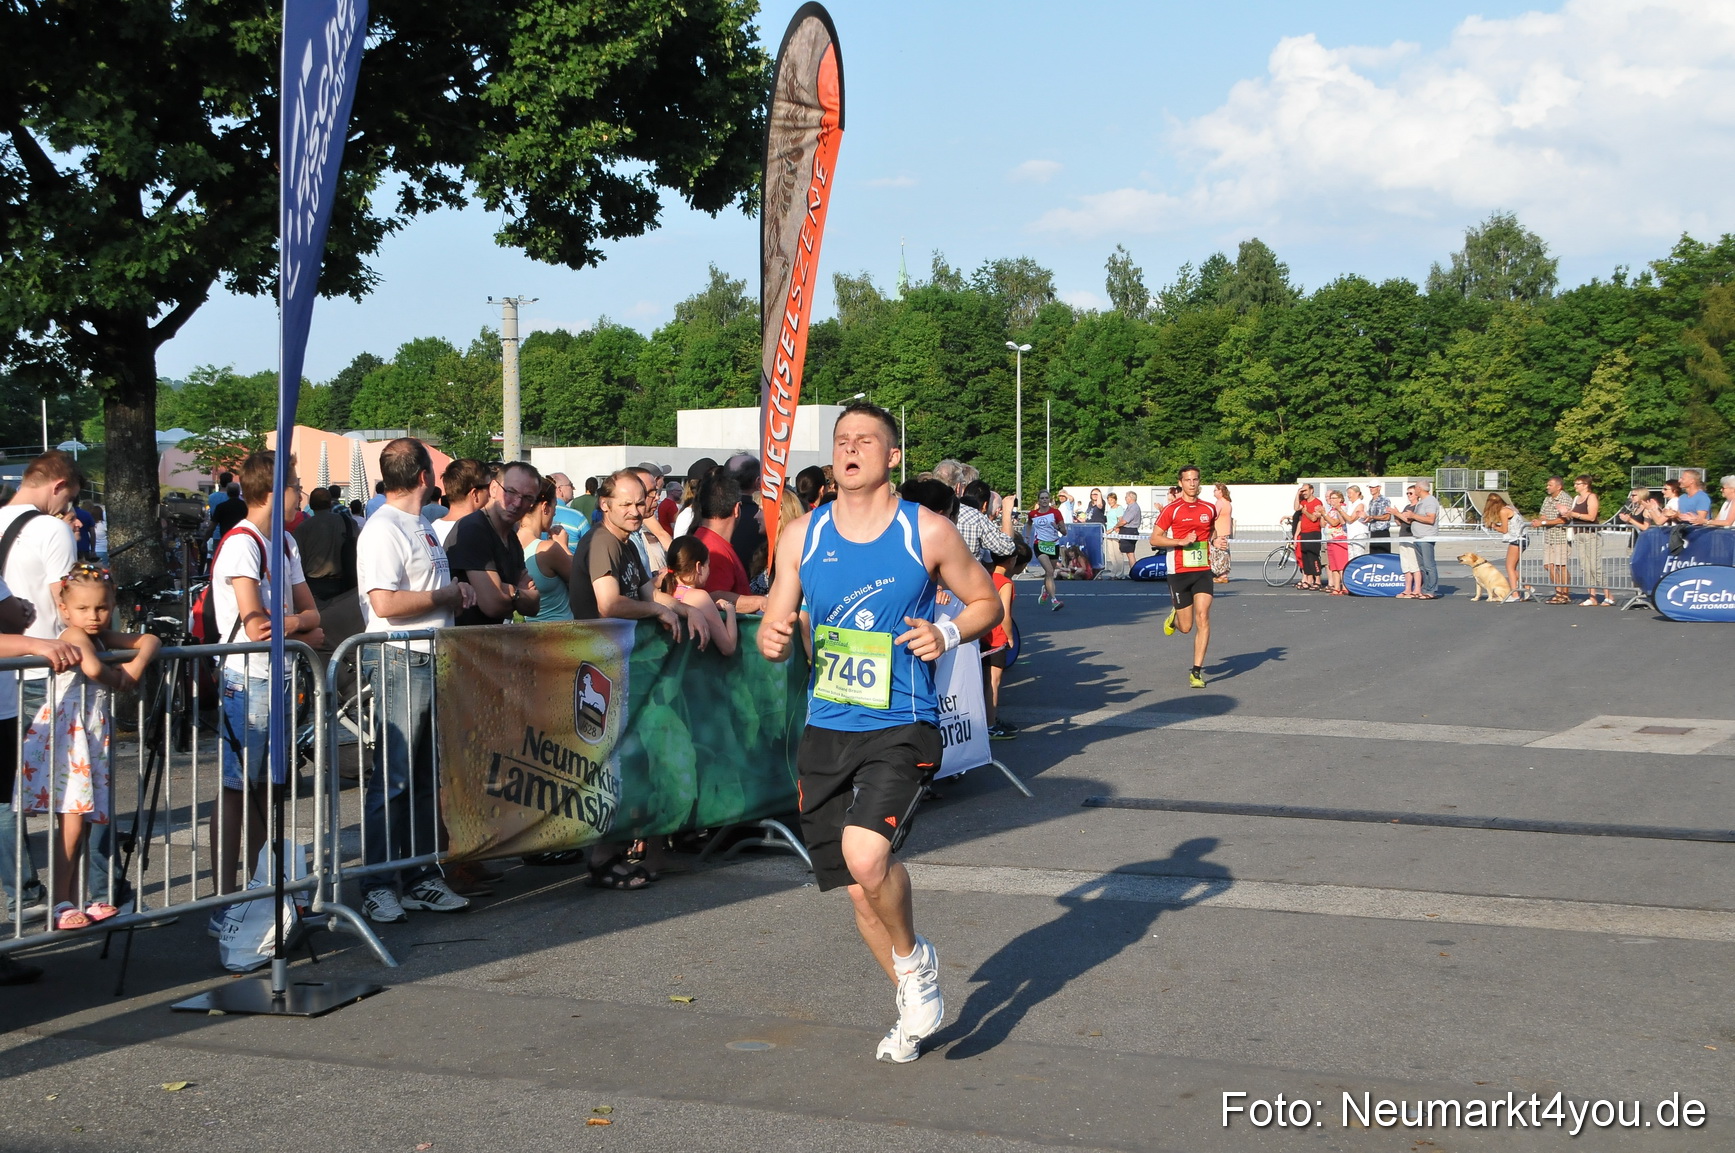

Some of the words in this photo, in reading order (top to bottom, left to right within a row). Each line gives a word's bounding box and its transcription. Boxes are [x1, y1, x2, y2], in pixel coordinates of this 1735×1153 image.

[1191, 550, 1203, 560] 13
[826, 604, 844, 623] Team
[843, 584, 873, 604] Schick
[875, 576, 895, 587] Bau
[1682, 590, 1735, 603] Fisch
[824, 652, 877, 688] 746
[580, 720, 597, 738] 1628
